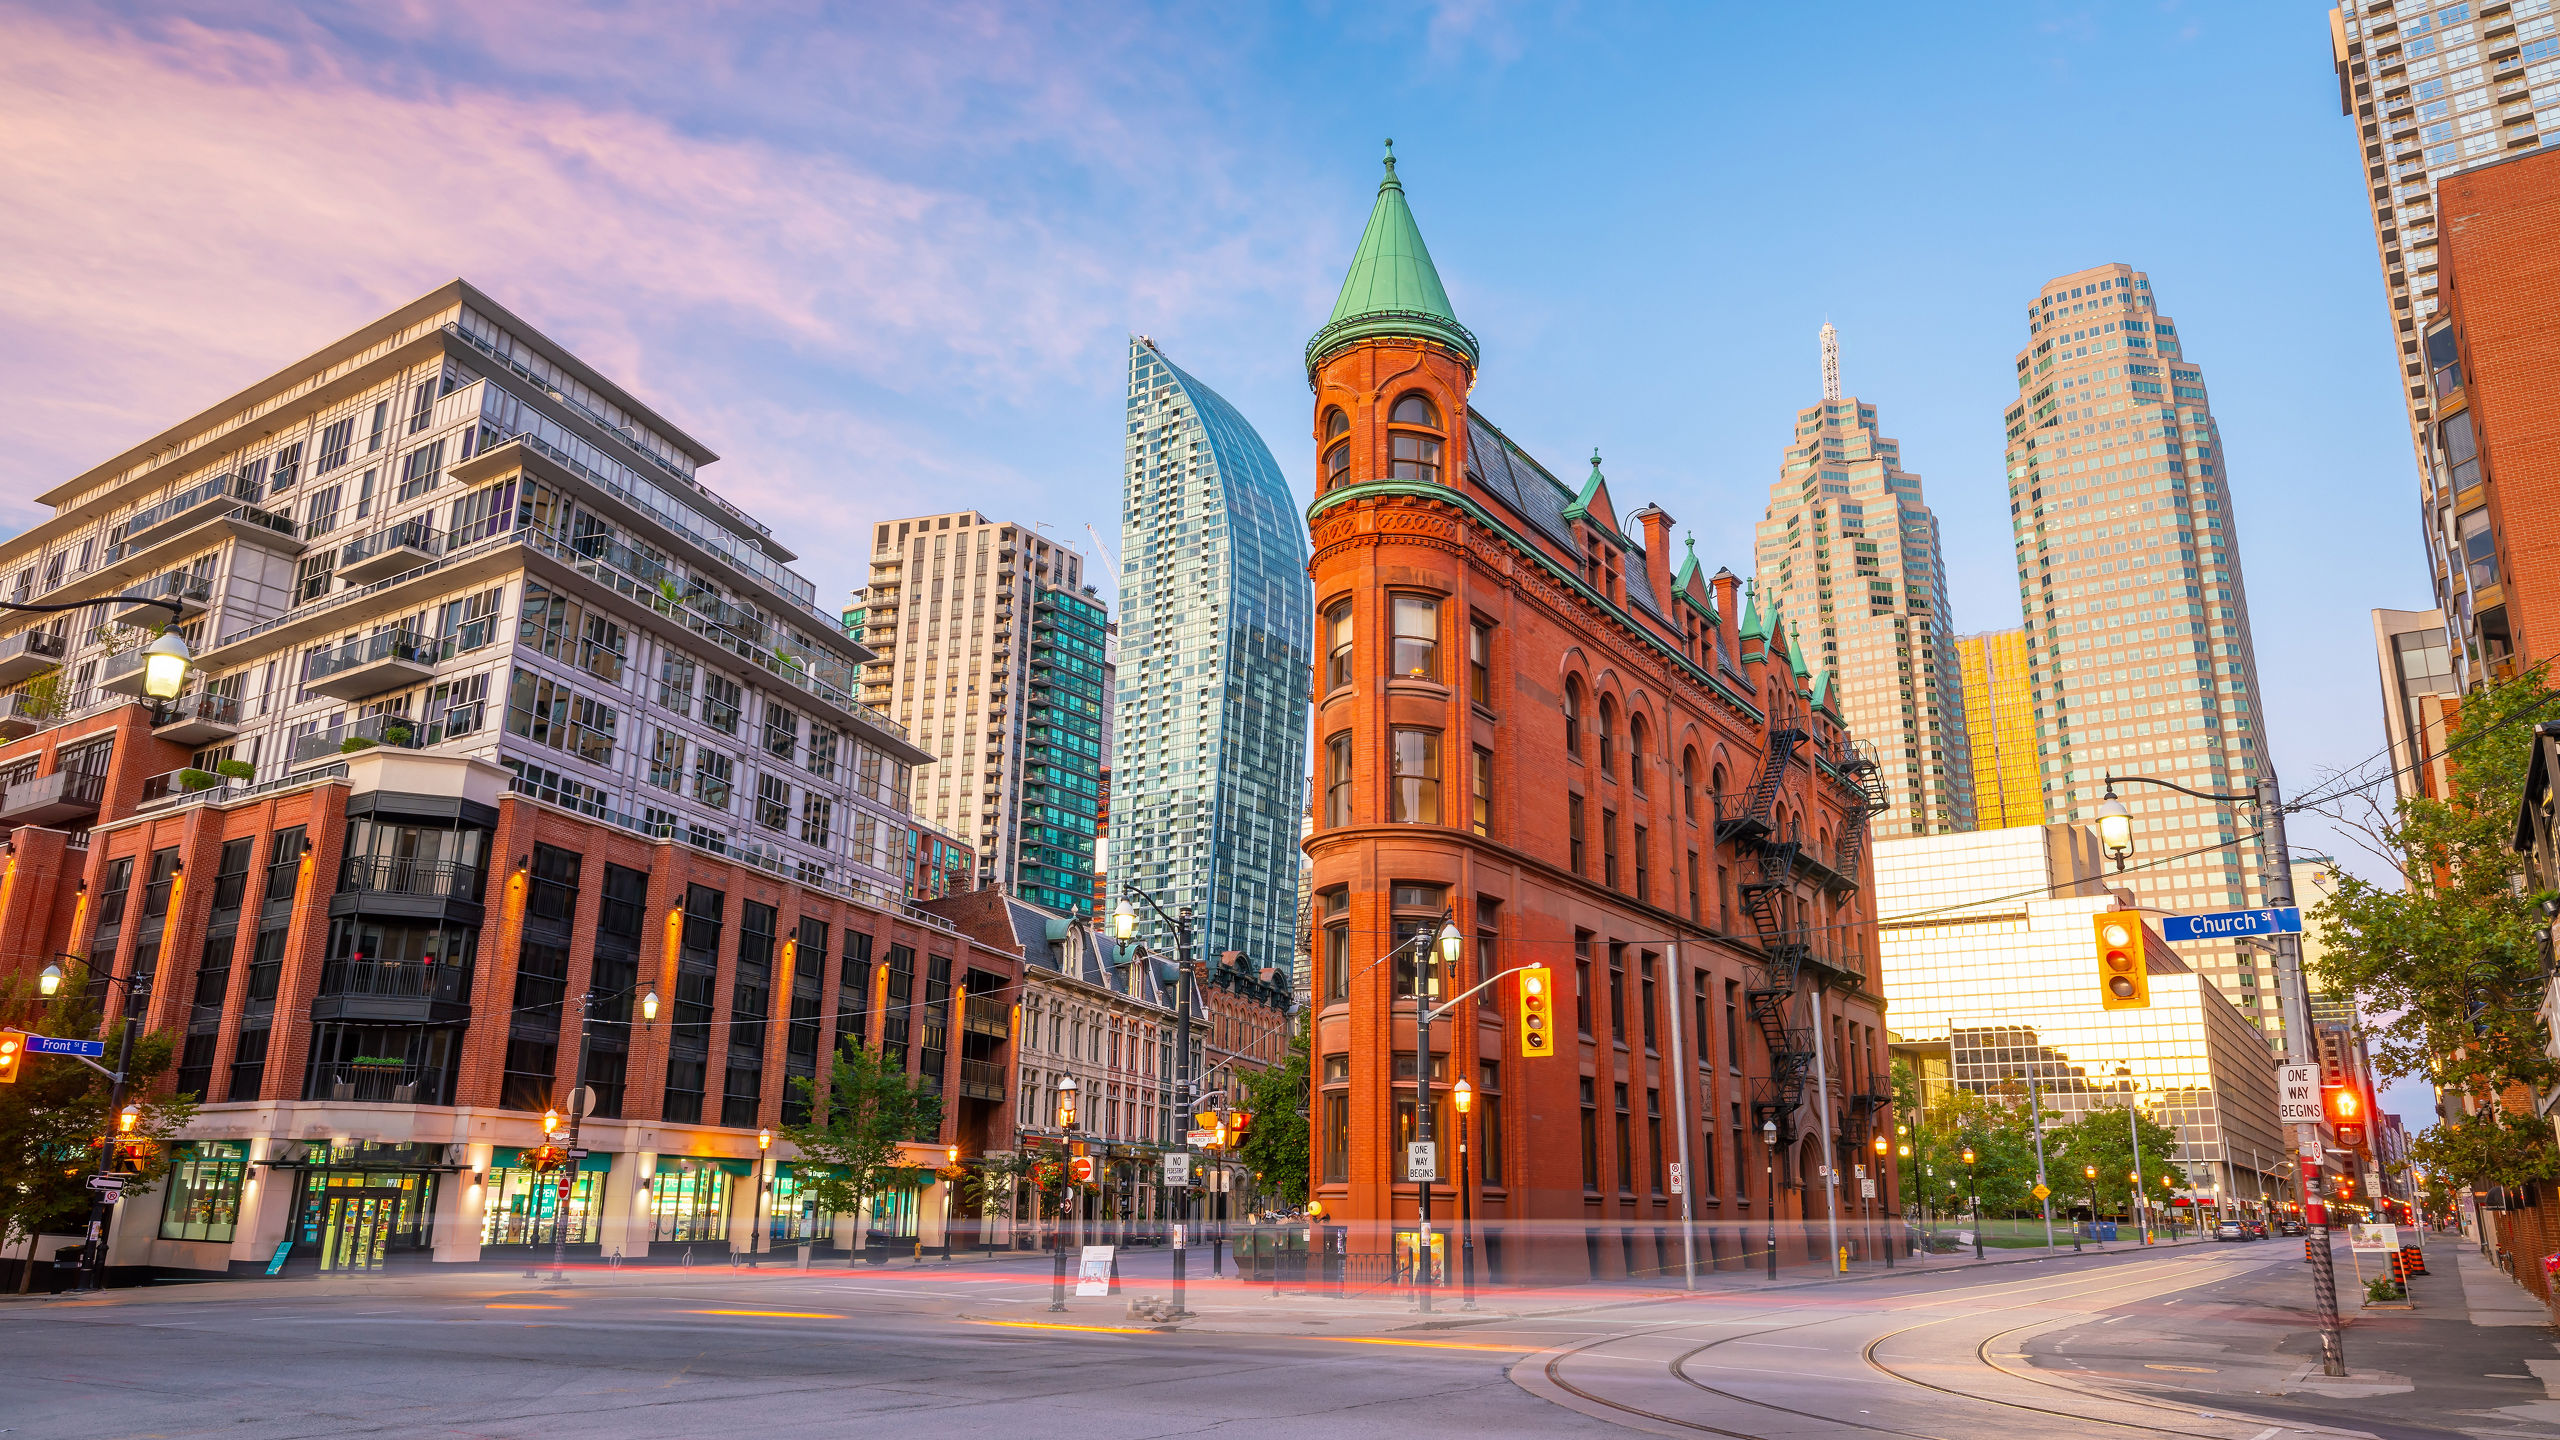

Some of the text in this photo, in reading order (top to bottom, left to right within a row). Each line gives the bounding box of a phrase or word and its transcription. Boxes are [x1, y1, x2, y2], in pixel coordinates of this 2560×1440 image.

[2189, 911, 2272, 934] Church St
[42, 1039, 71, 1051] Front
[81, 1042, 88, 1052] E
[2287, 1069, 2308, 1082] ONE
[2287, 1086, 2309, 1100] WAY
[2281, 1104, 2321, 1118] BEGINS
[1414, 1145, 1428, 1155] ONE
[1172, 1156, 1182, 1166] NO
[1414, 1157, 1428, 1166] WAY
[1409, 1168, 1434, 1178] BEGINS
[541, 1205, 553, 1216] pm
